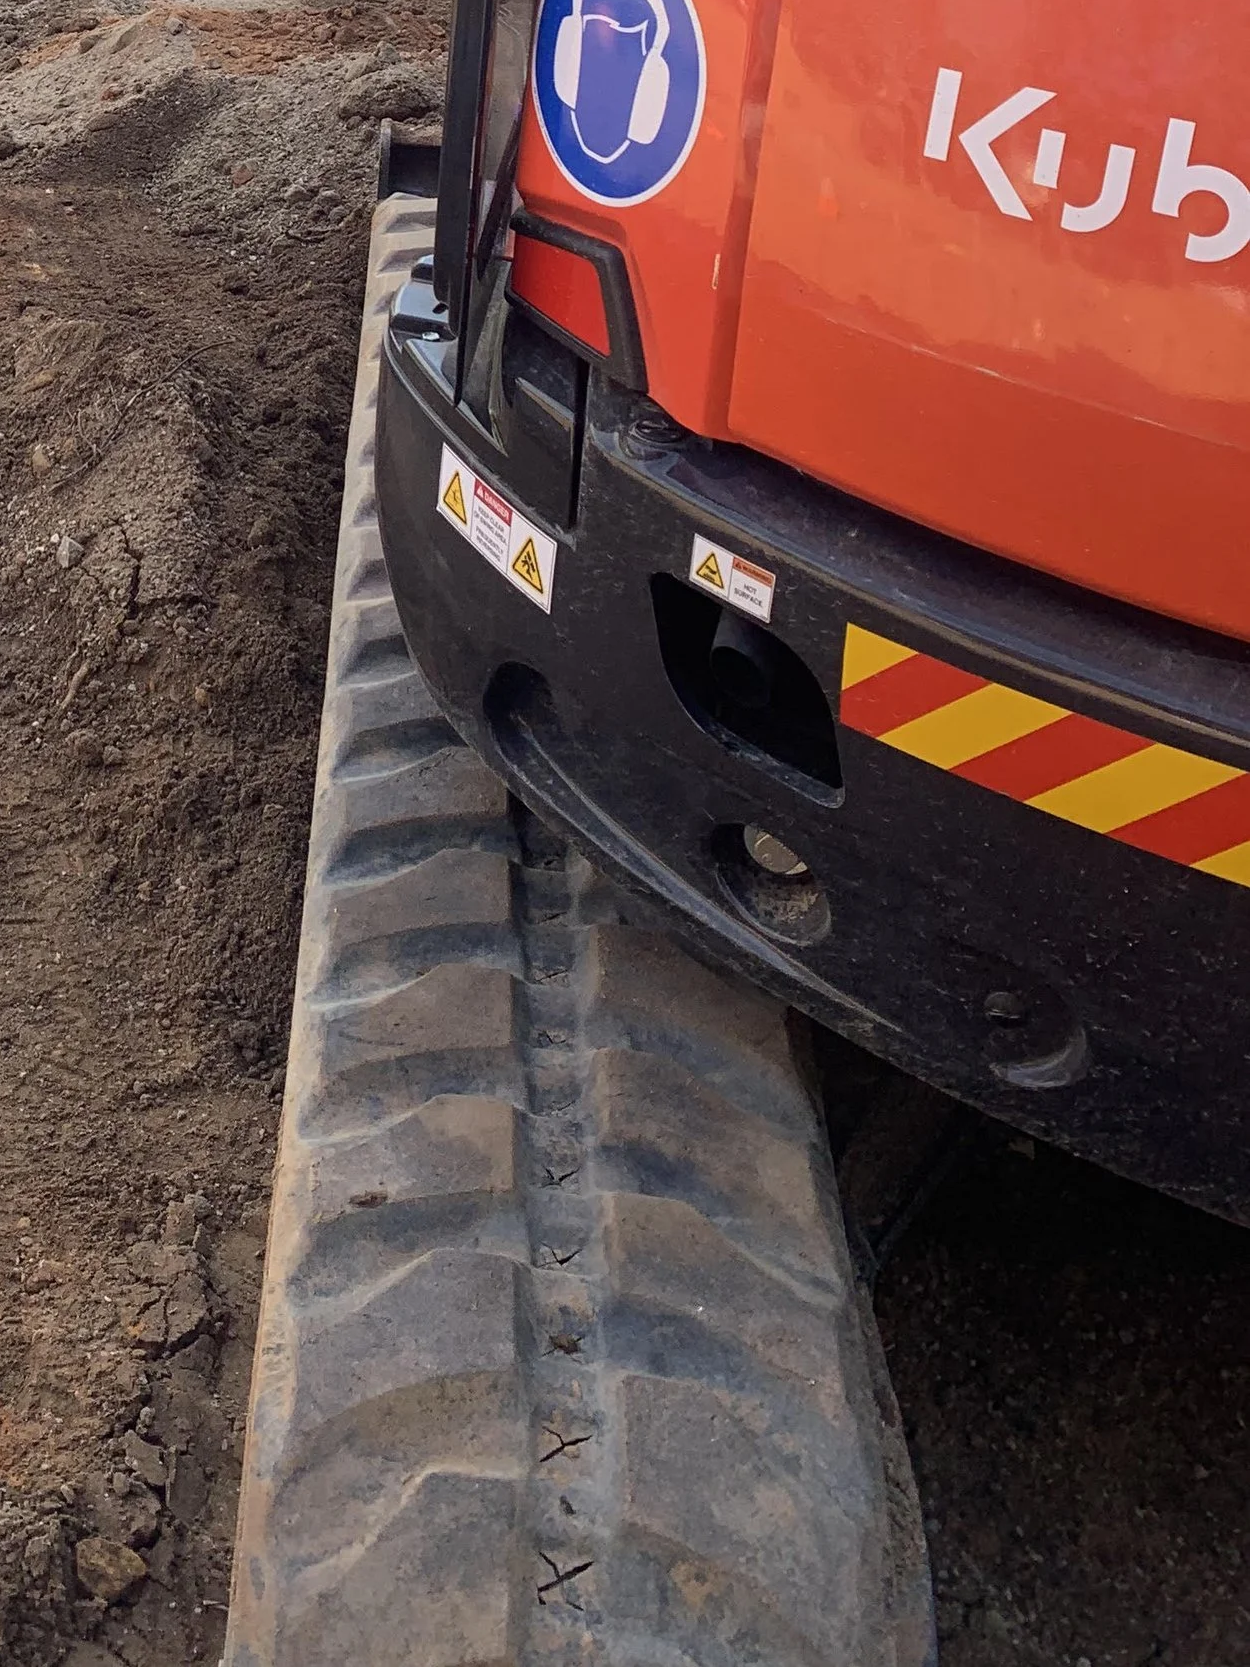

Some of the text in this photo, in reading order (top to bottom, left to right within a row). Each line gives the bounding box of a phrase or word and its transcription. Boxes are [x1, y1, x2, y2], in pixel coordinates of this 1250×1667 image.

[922, 66, 1250, 263] Kub
[484, 491, 510, 519] DANGER
[734, 587, 763, 607] SURFACE
[744, 583, 757, 595] HOT
